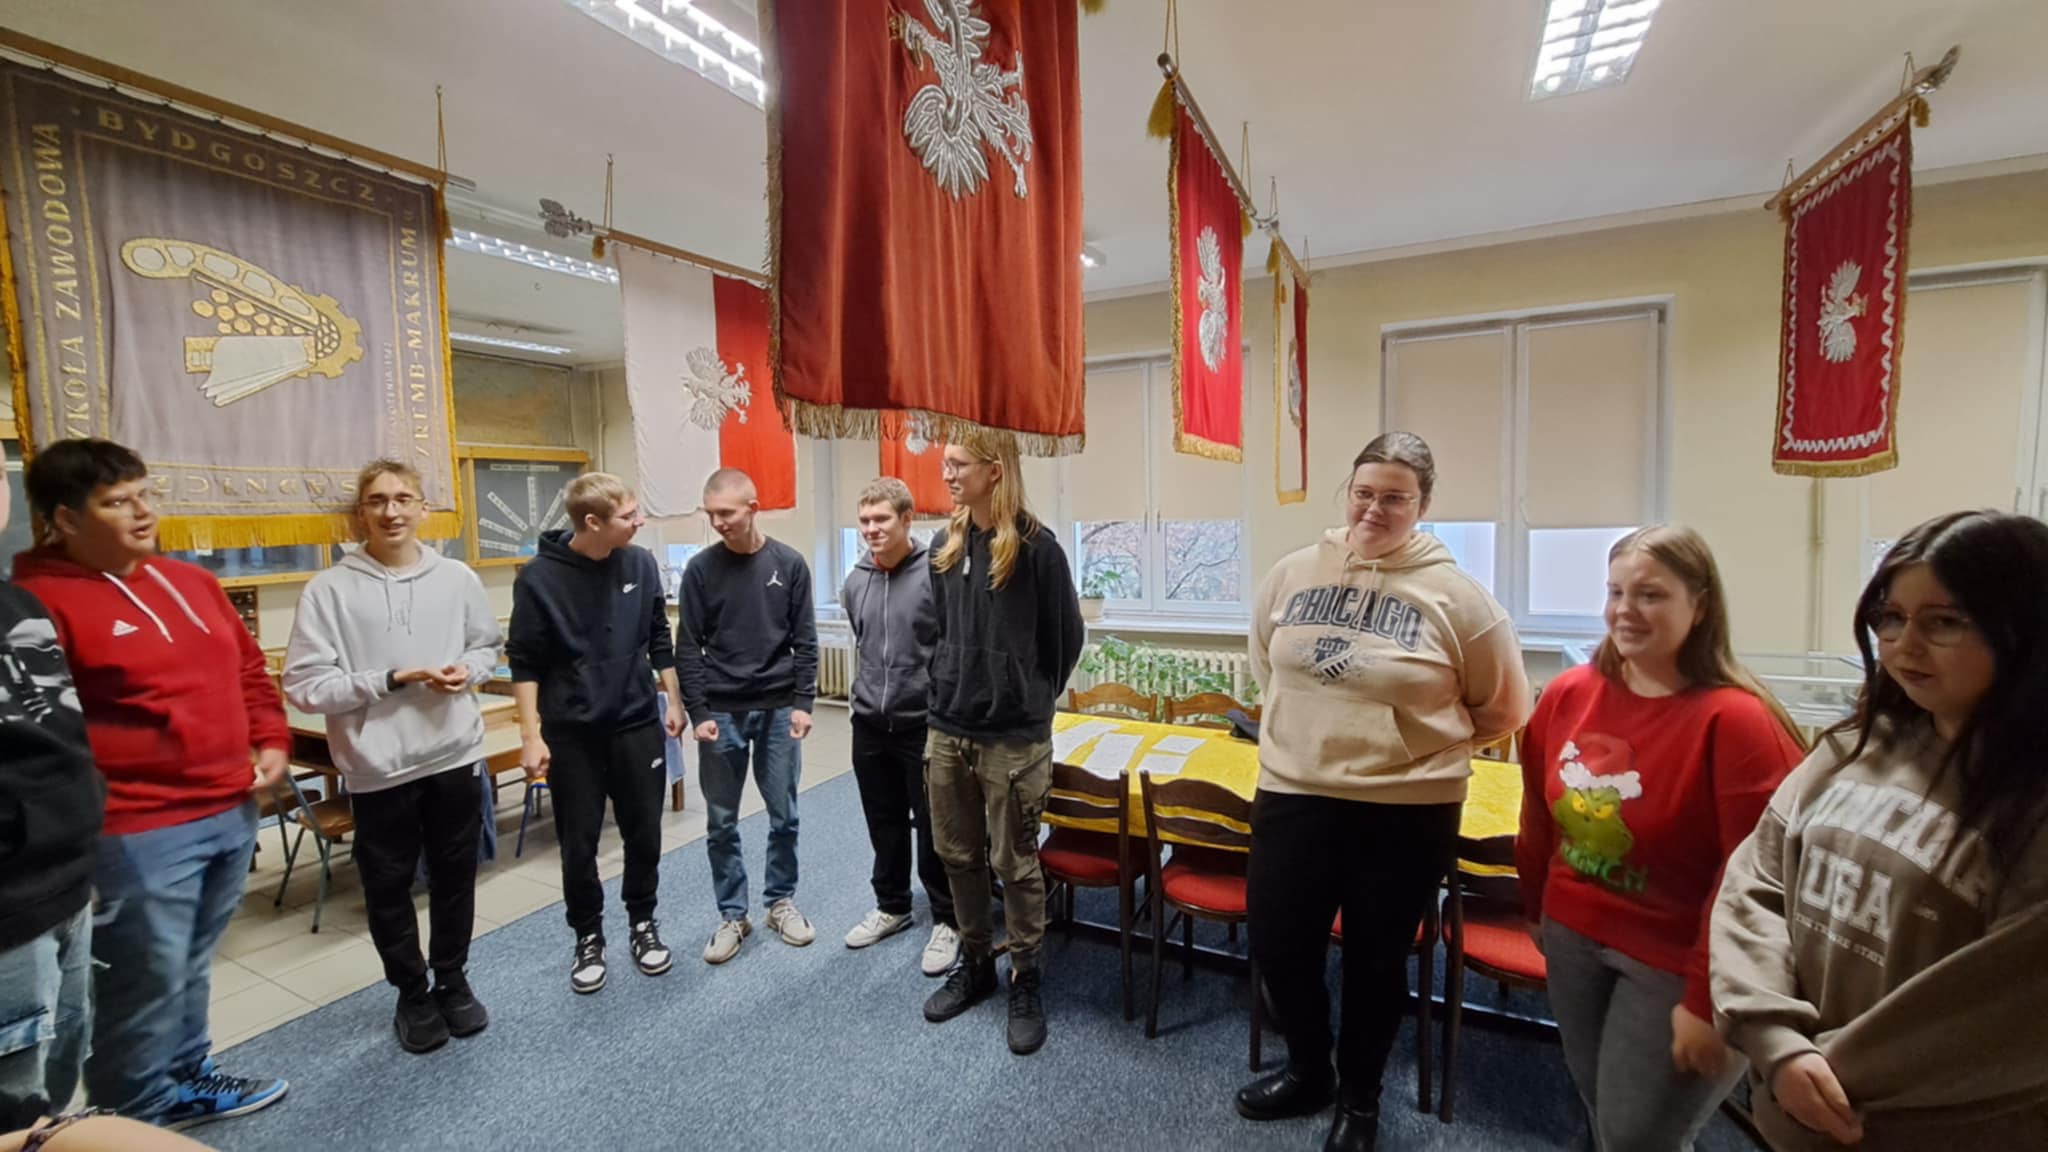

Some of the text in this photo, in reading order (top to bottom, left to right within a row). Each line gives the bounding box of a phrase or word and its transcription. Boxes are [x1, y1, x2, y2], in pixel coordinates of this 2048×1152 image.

[97, 108, 377, 201] BYDGOSZCZ
[32, 123, 90, 441] ZKOŁA ZAWODOWA
[1277, 583, 1424, 653] CHICAGO
[1801, 845, 1893, 945] USA
